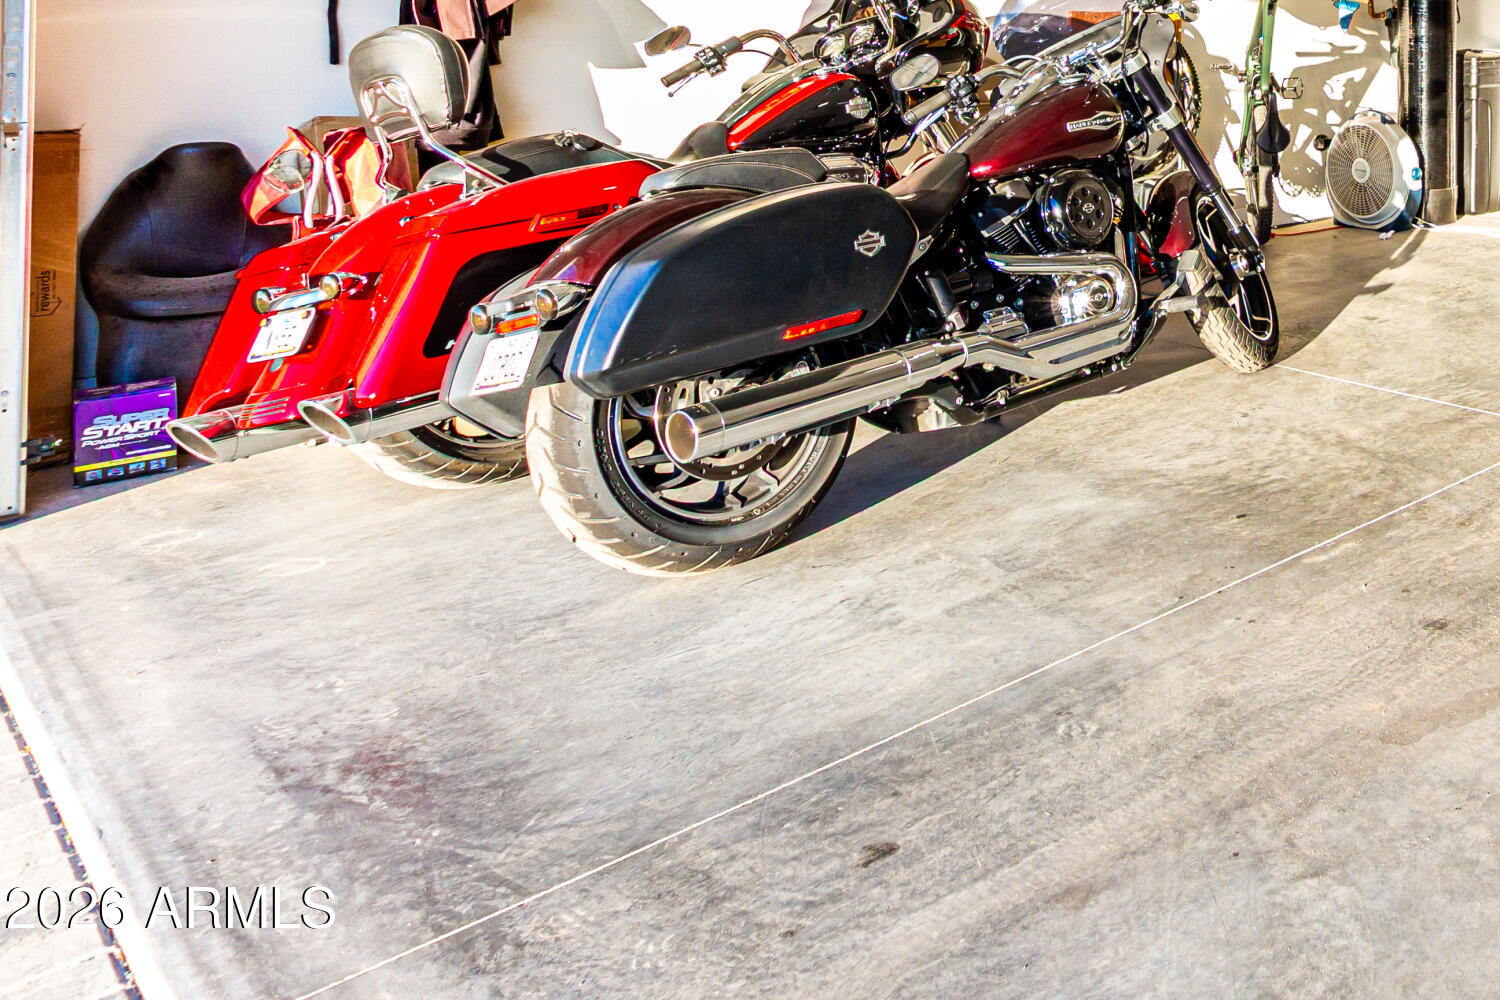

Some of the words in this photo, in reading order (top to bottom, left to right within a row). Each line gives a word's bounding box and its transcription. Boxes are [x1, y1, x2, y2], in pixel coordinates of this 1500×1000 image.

[34, 270, 51, 311] rewards
[81, 416, 169, 441] START
[93, 407, 169, 427] SUPER
